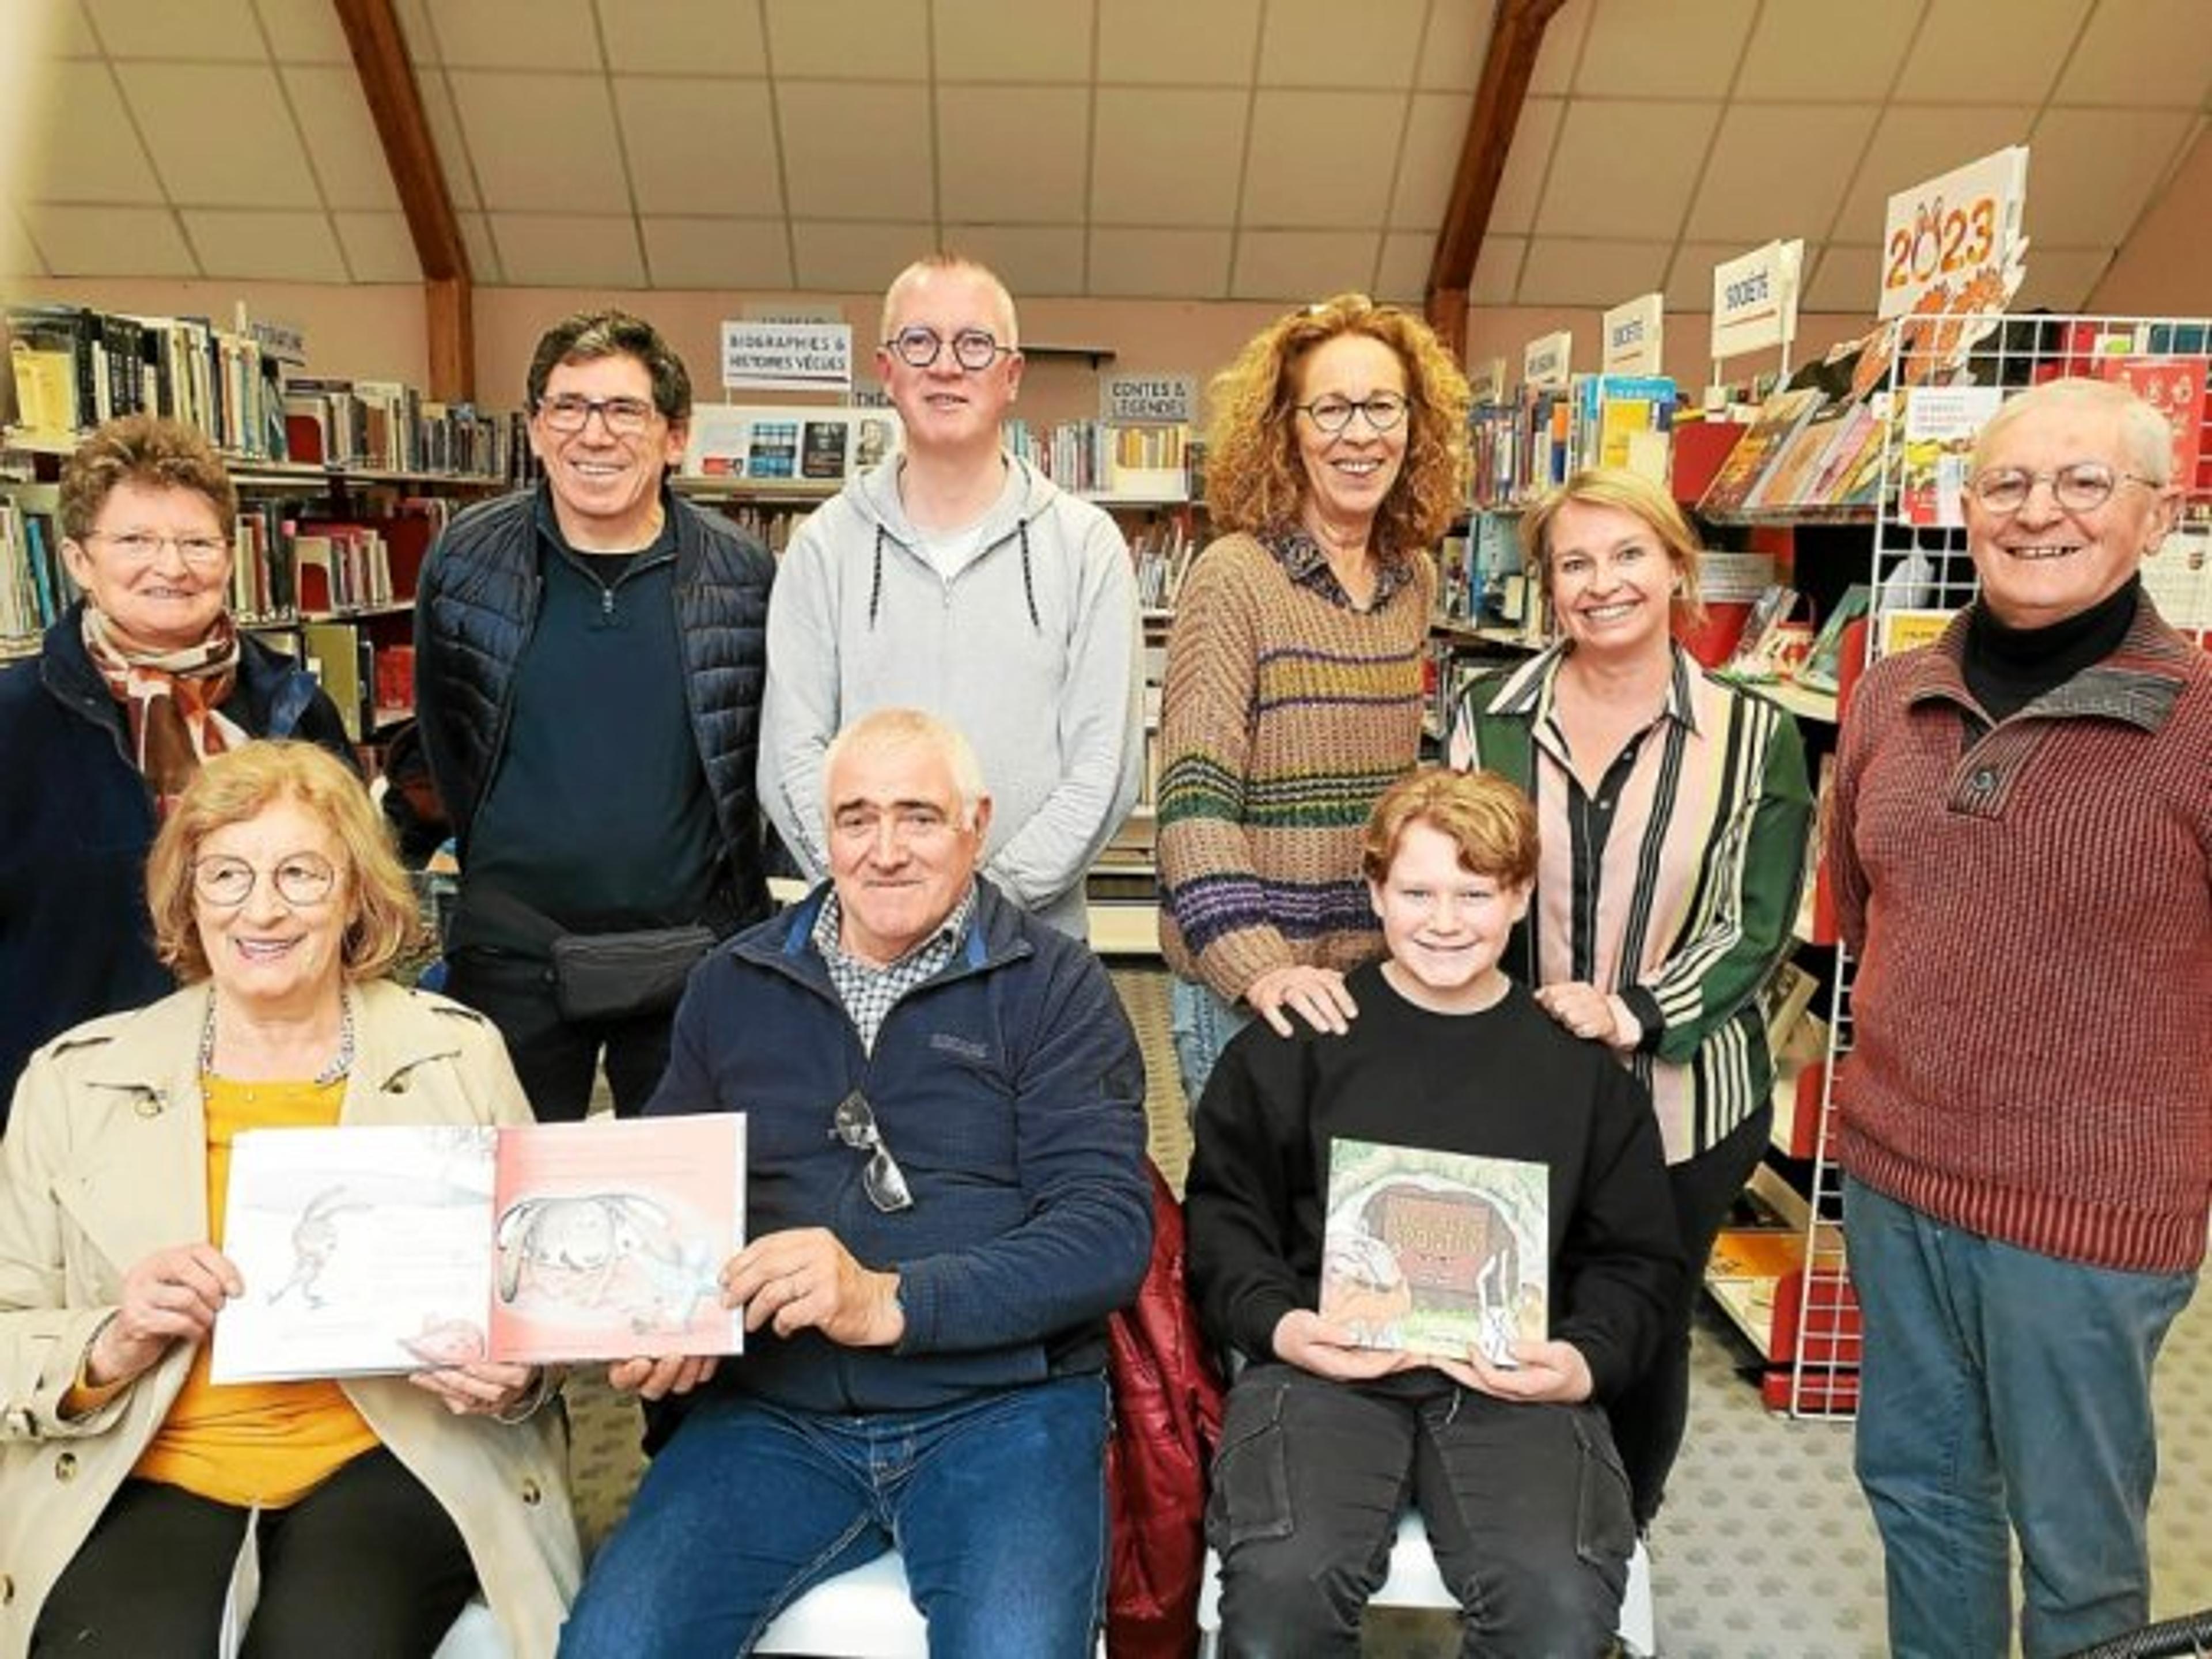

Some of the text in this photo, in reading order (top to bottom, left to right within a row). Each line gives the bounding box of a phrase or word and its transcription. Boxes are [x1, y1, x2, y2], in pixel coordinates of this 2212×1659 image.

[1885, 197, 1994, 289] 2023
[730, 335, 846, 351] BIOGRAPHIES &
[729, 353, 845, 370] HISTOIRES VÉCUES
[1112, 382, 1186, 397] CONTES &
